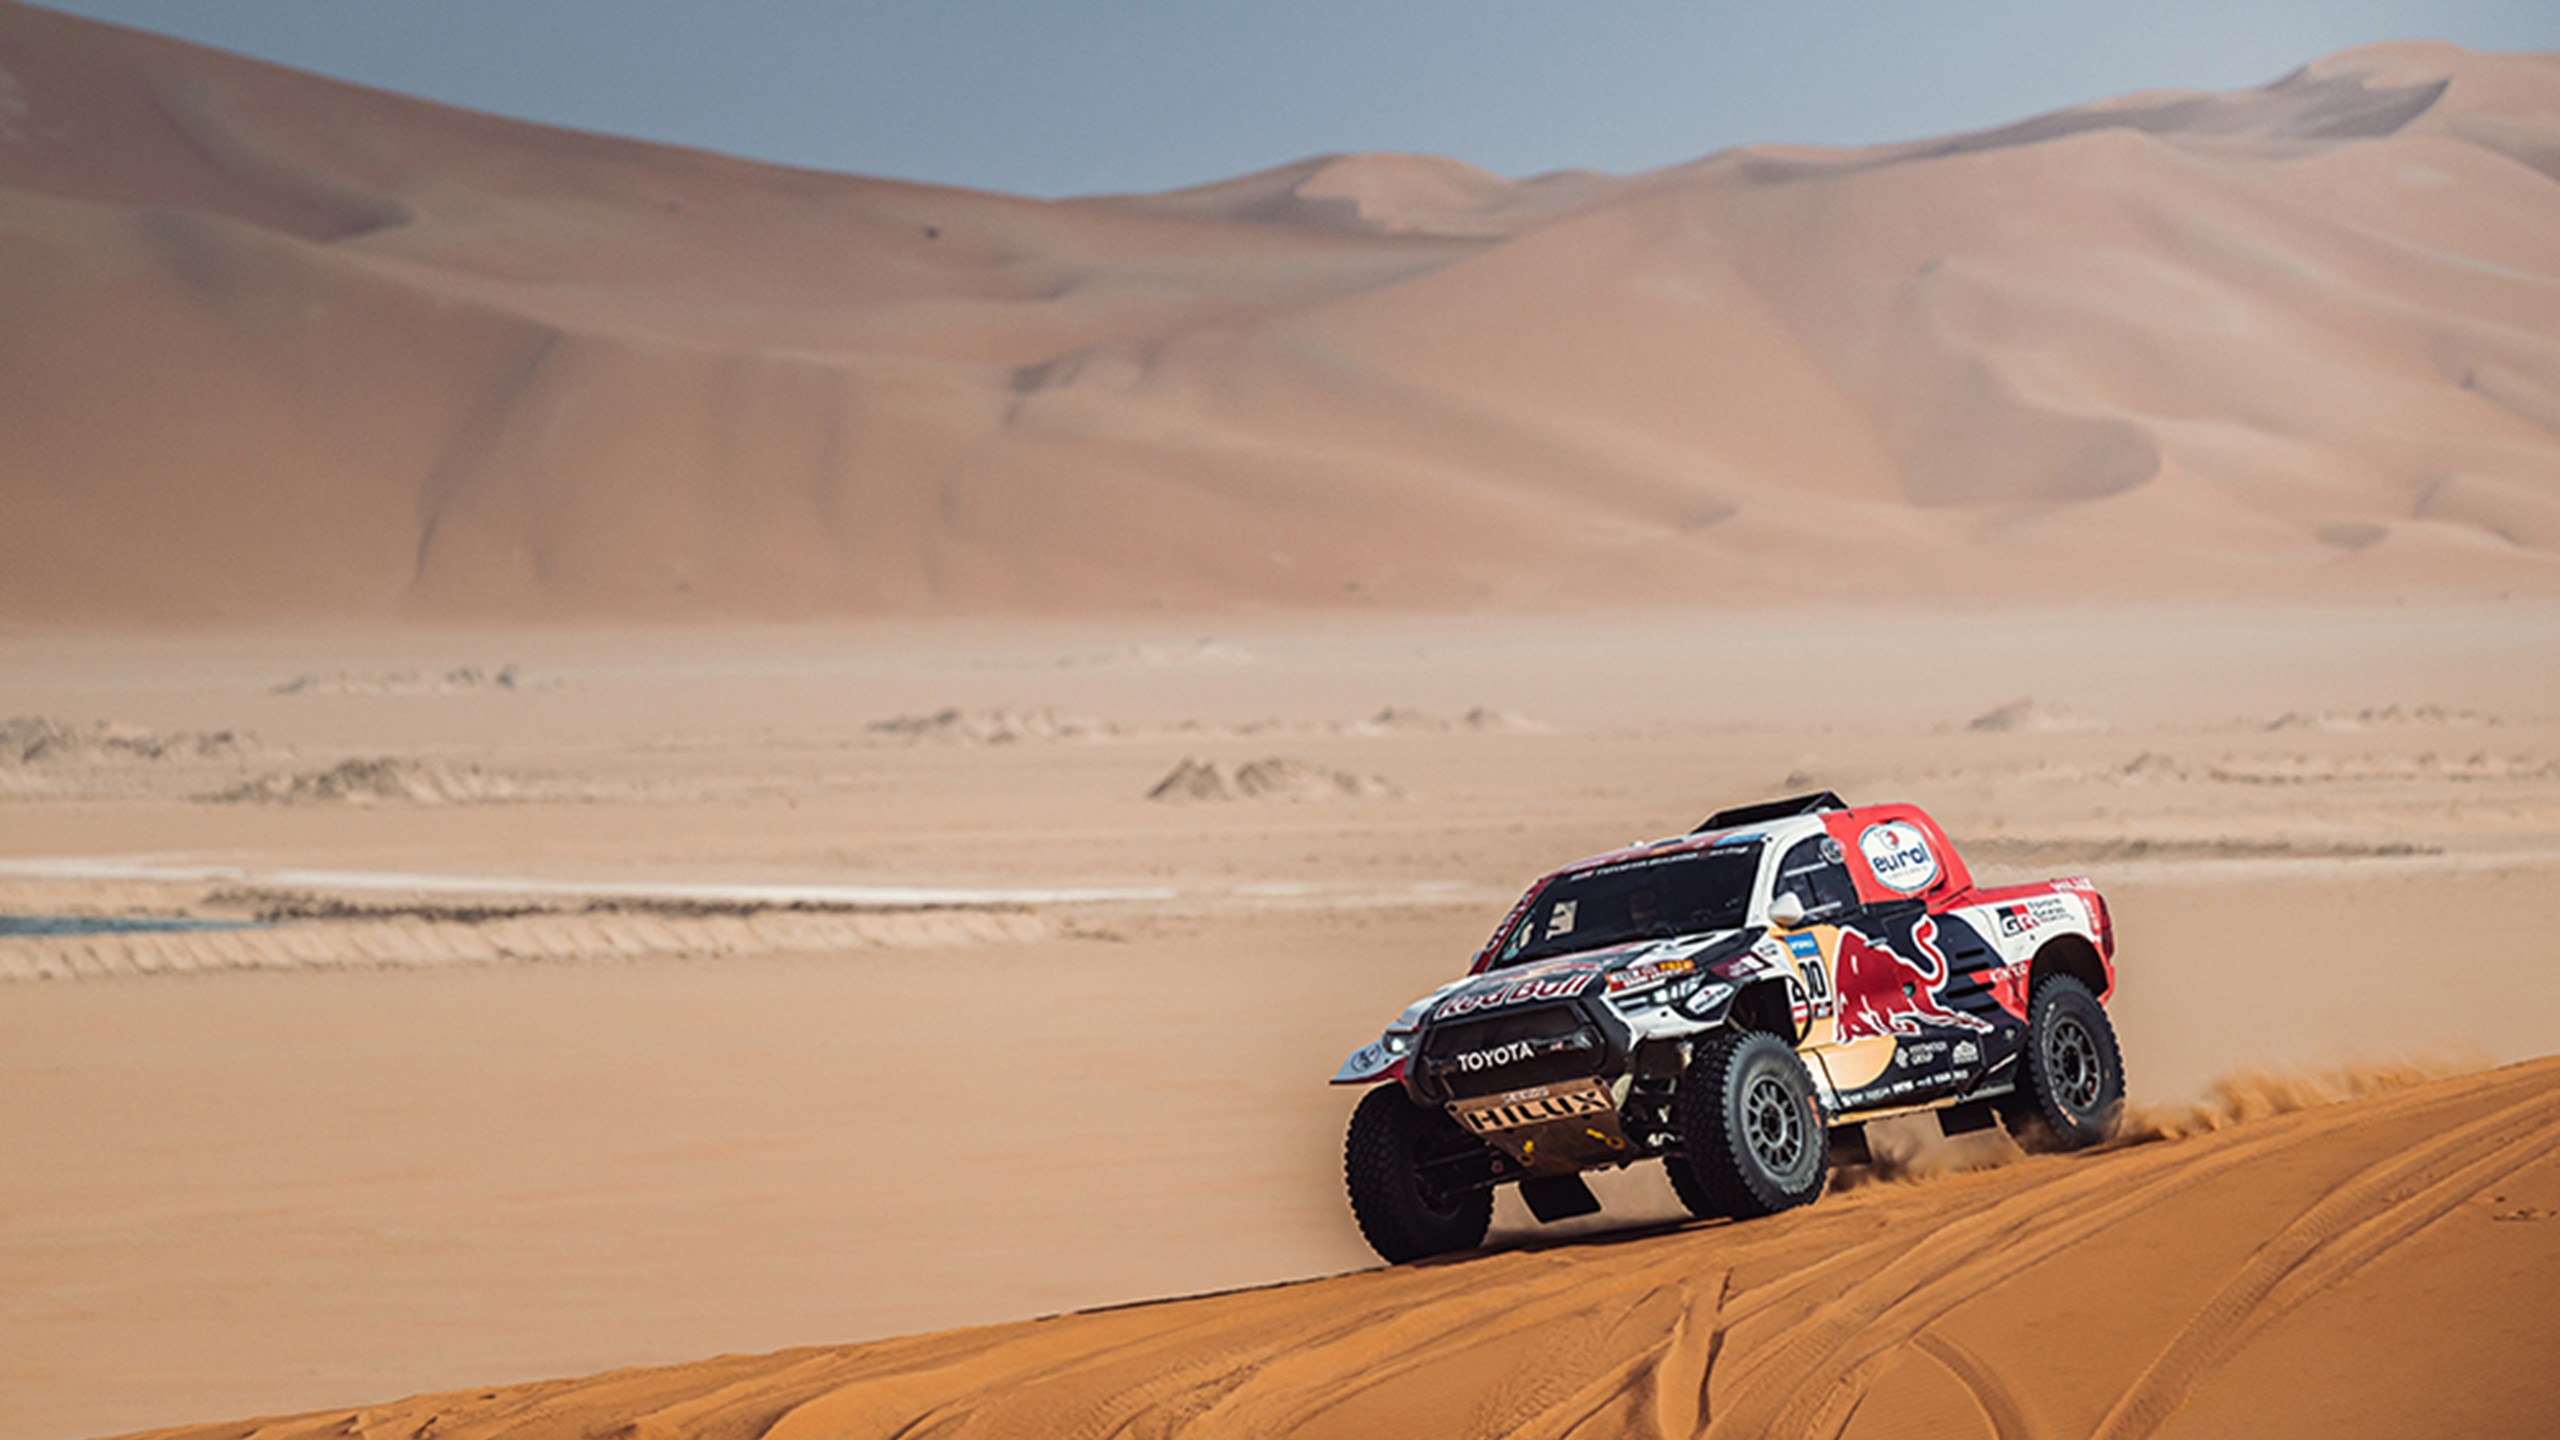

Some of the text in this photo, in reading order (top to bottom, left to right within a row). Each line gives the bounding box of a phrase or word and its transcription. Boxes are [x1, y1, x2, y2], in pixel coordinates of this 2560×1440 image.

[1872, 841, 1930, 873] eurol
[1432, 982, 1512, 1021] Red
[1505, 973, 1597, 1004] Bull
[1456, 1041, 1535, 1073] TOYOTA
[1467, 1090, 1606, 1130] HILUX
